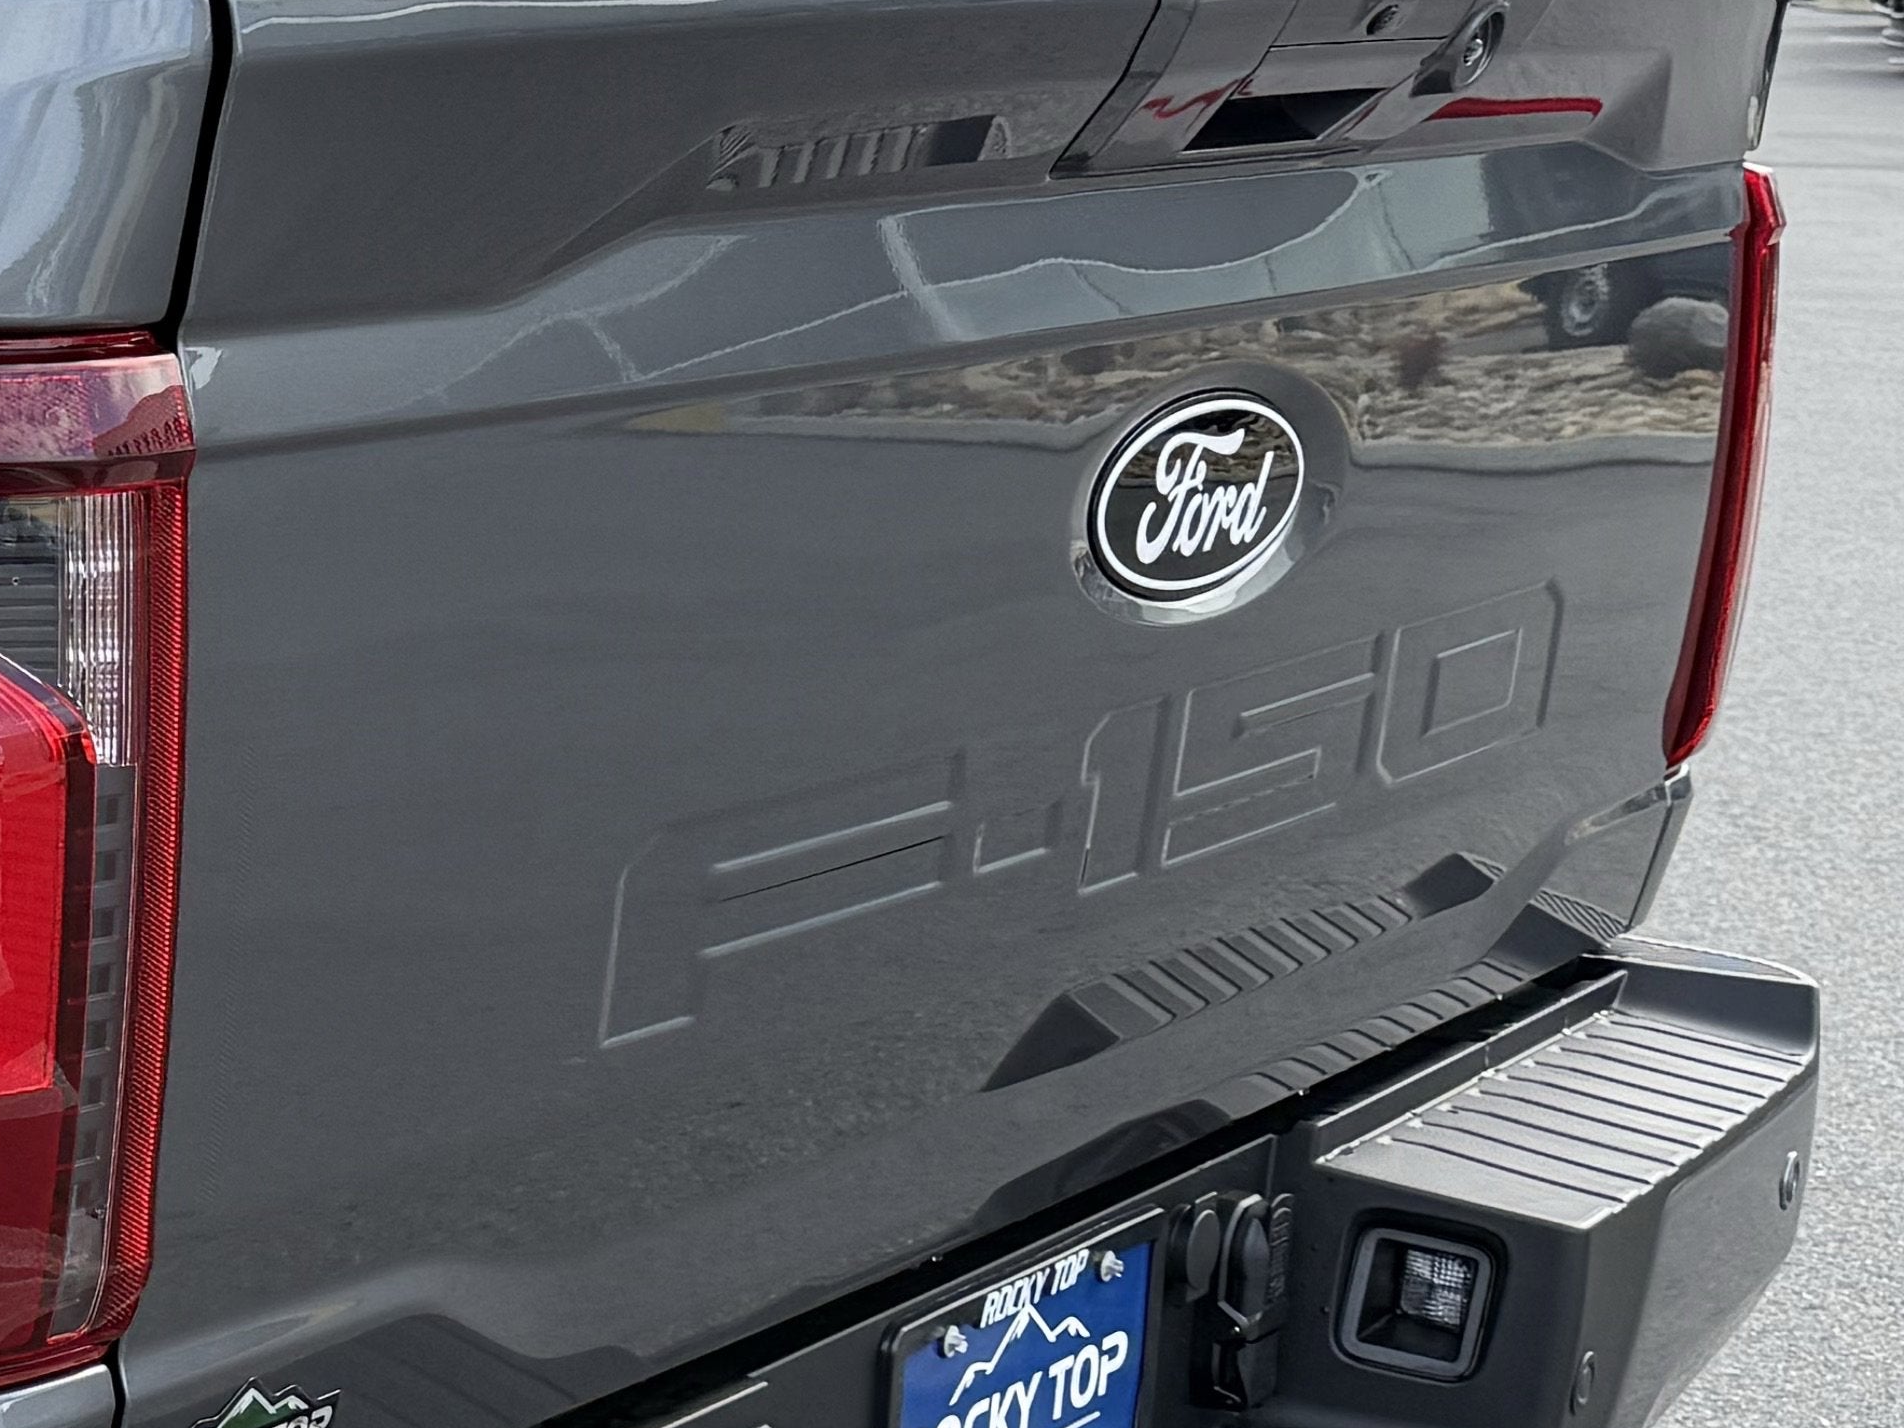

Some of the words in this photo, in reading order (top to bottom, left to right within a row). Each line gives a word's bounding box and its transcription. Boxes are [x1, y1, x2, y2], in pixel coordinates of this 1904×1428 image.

[1136, 428, 1275, 564] Ford
[598, 578, 1562, 1048] F-150
[980, 1266, 1050, 1328] ROCKY
[1050, 1248, 1090, 1296] TOP
[1048, 1330, 1129, 1421] TOP
